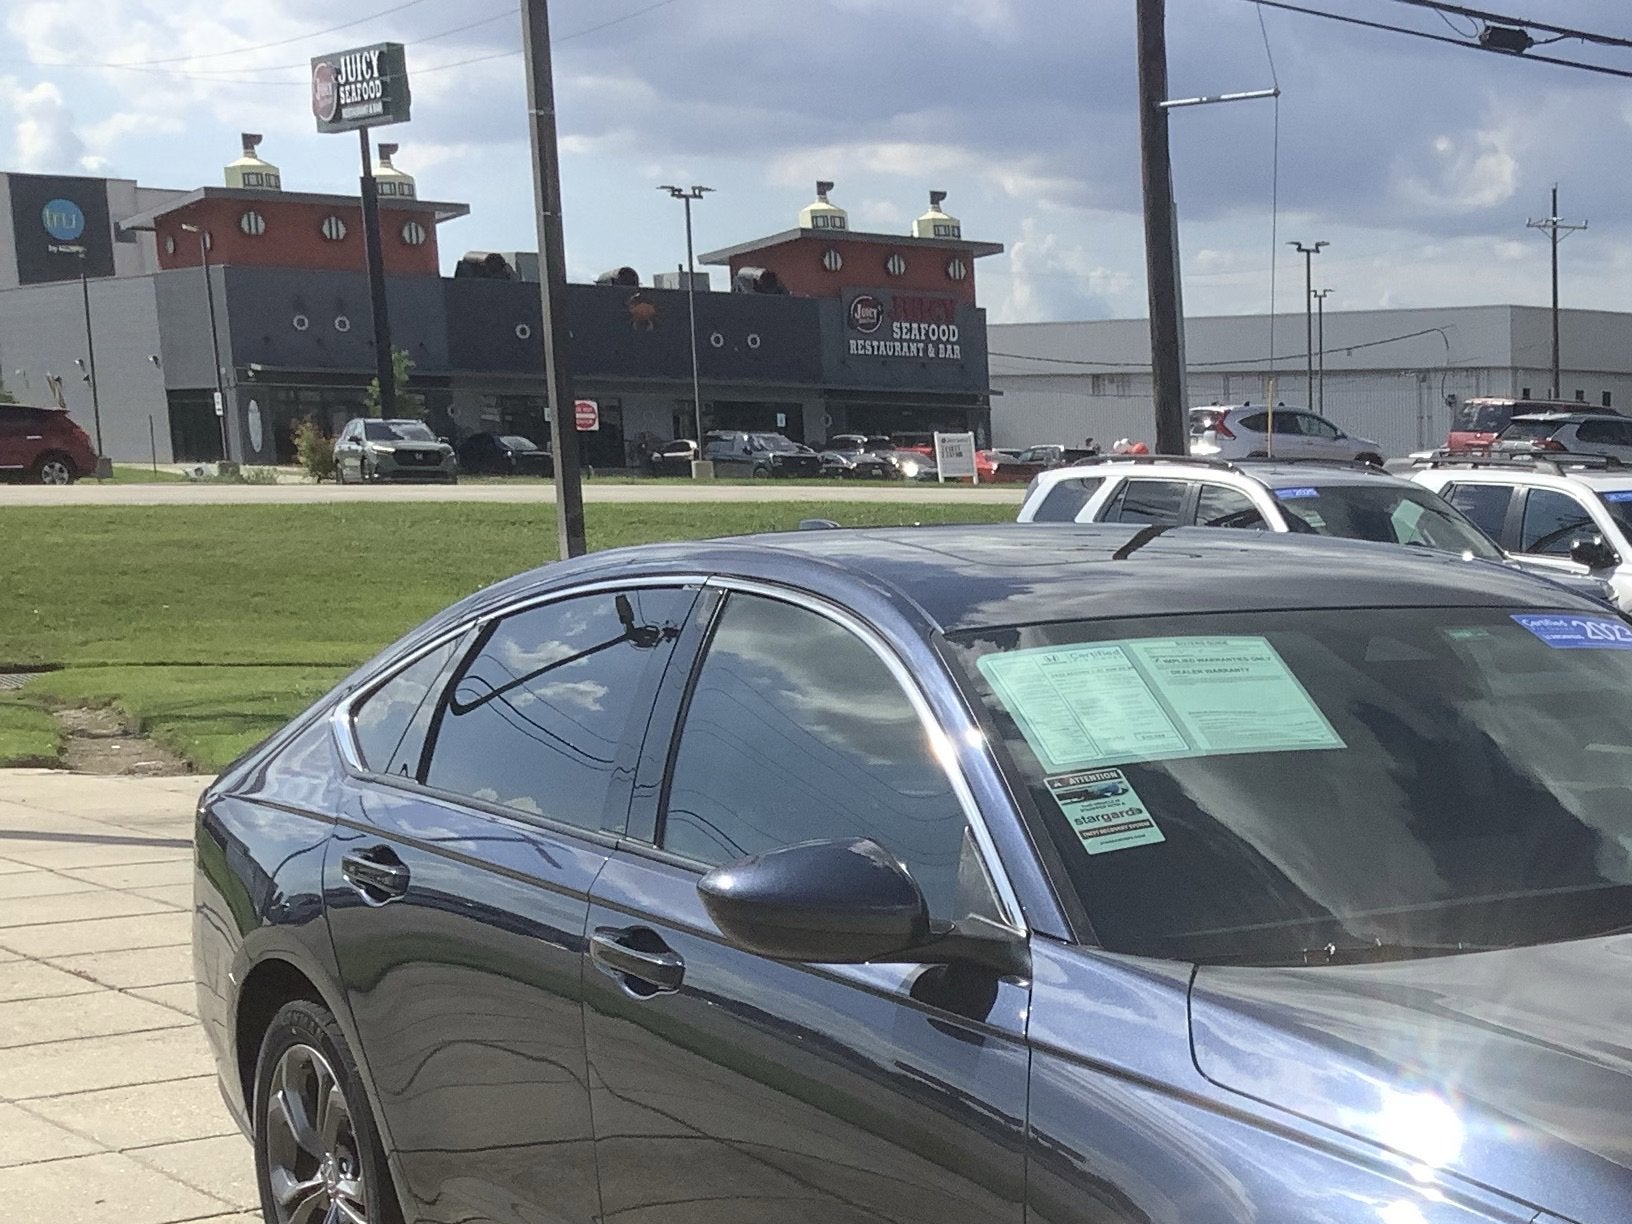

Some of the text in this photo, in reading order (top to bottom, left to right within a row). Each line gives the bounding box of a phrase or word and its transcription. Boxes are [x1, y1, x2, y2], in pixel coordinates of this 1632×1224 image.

[338, 50, 379, 84] JUICY
[340, 80, 382, 104] SEAFOOD
[892, 321, 959, 342] SEAFOOD
[849, 339, 961, 359] RESTAURANT & BAR
[1069, 771, 1118, 786] ATTENTION
